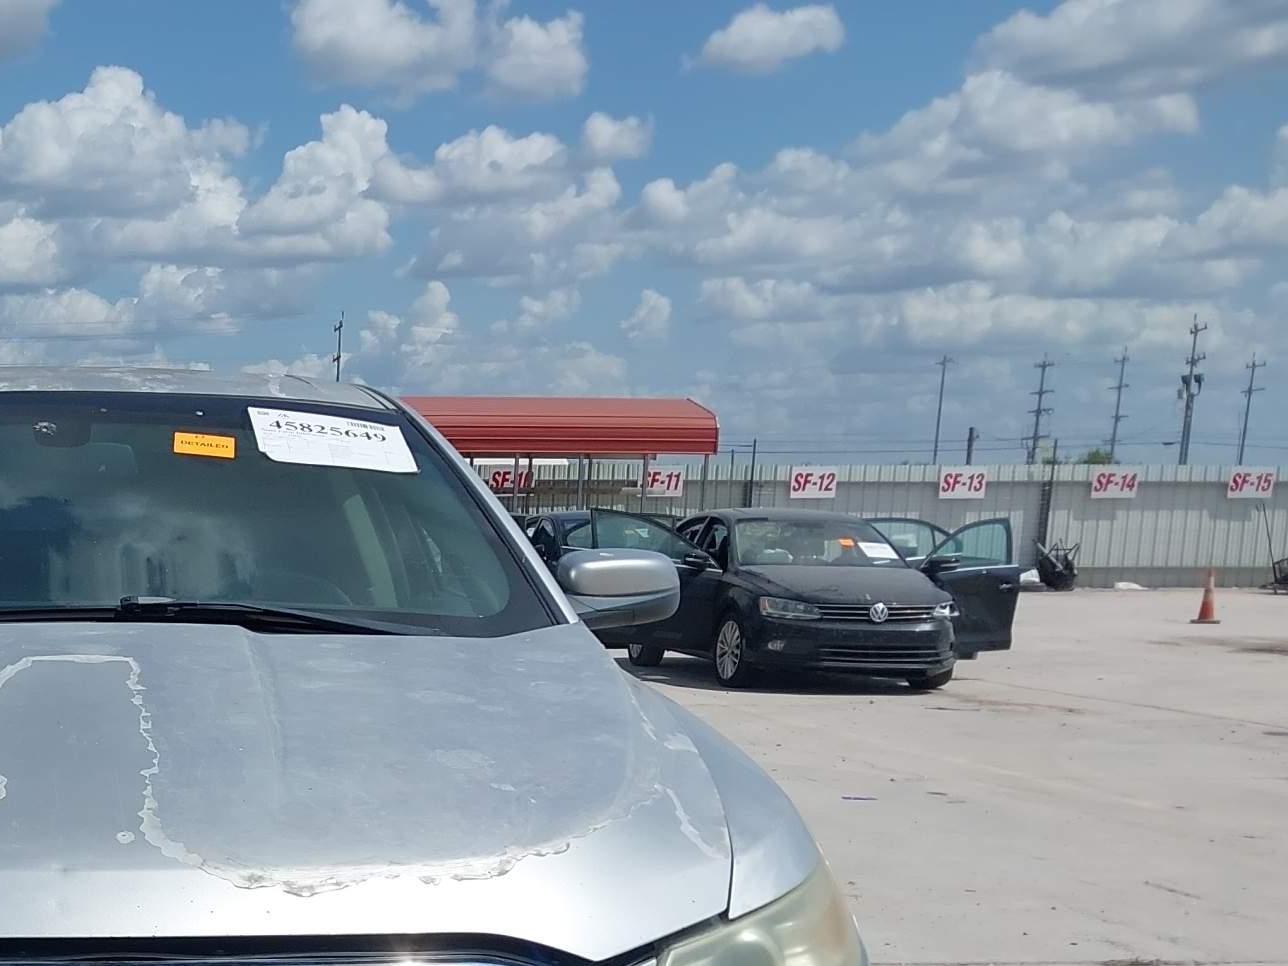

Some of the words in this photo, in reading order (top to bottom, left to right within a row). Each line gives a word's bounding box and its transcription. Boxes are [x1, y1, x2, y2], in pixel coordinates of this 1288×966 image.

[268, 419, 387, 443] 45825649
[792, 472, 836, 492] SF-12
[941, 472, 985, 492] SF-13
[1094, 472, 1138, 492] SF-14
[1229, 472, 1274, 492] SF-15
